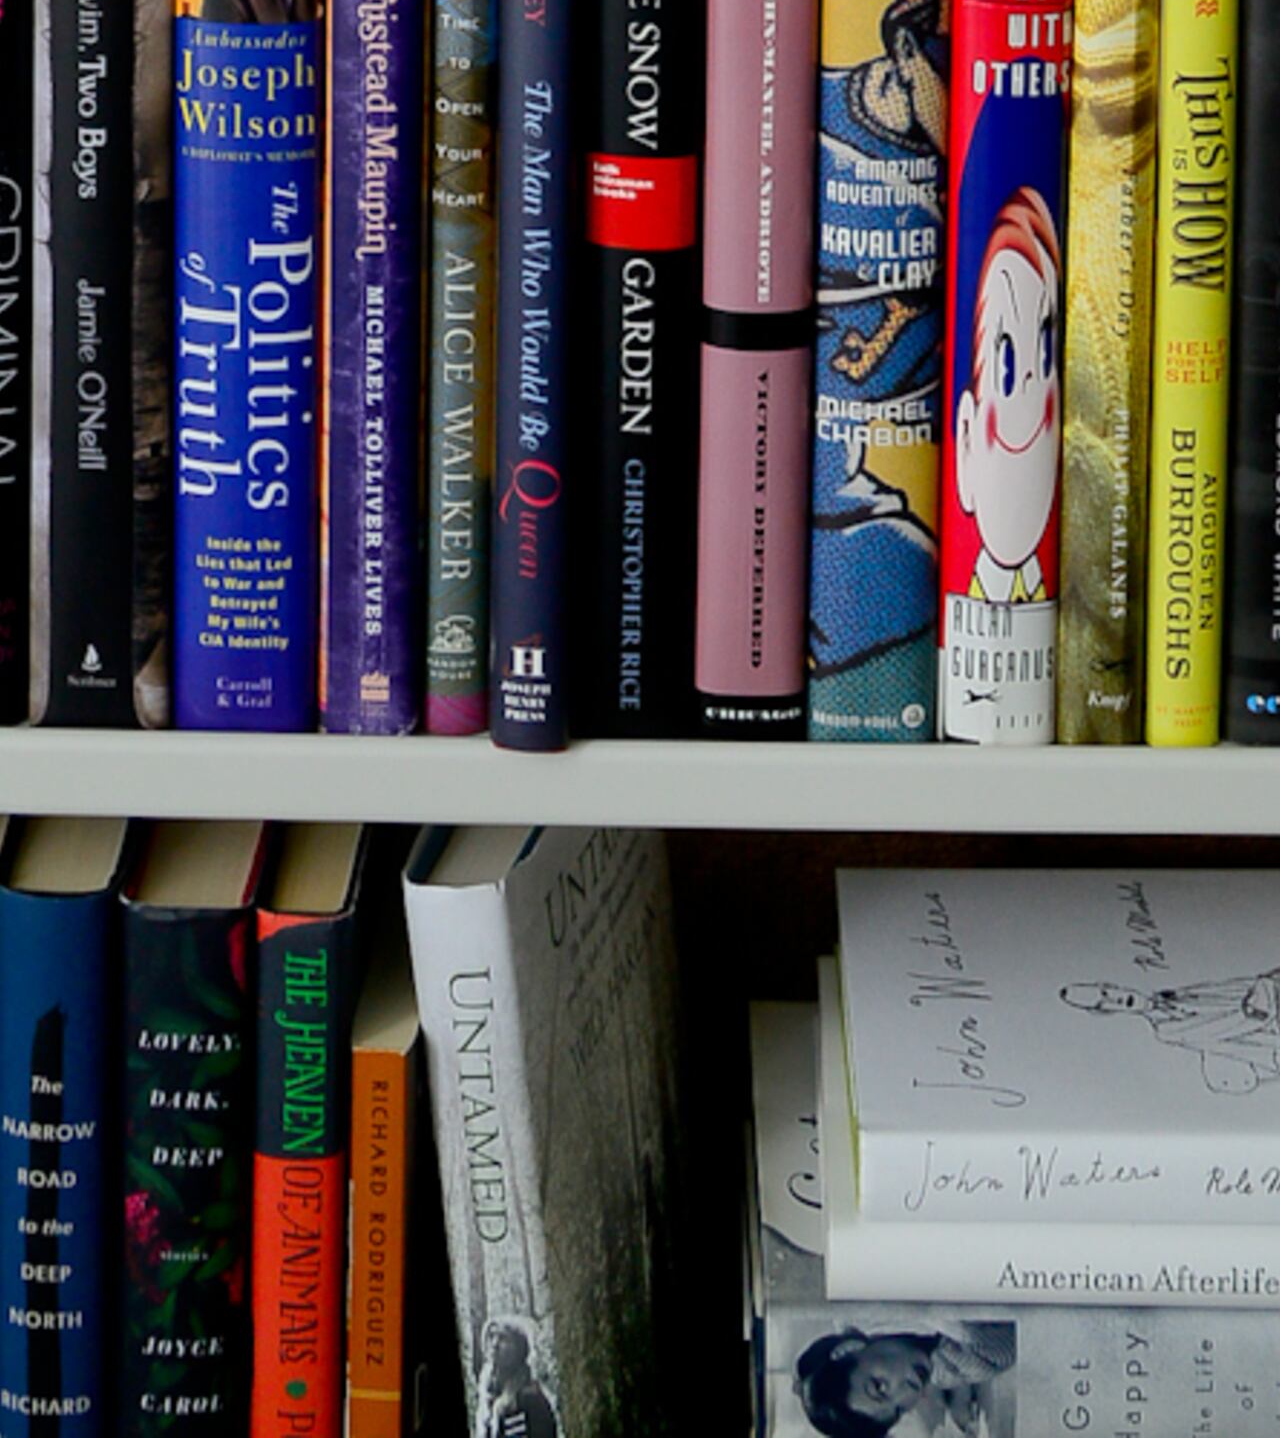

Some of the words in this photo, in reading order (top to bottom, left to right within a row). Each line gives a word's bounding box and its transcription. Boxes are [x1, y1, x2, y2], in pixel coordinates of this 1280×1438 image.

[176, 49, 317, 100] Joseph
[178, 97, 317, 139] Wilson
[440, 252, 475, 385] ALICE
[437, 399, 476, 583] WALKER
[2, 1118, 96, 1143] NARROW
[445, 968, 510, 1246] UNTAMED
[372, 1079, 389, 1198] RICHARD
[16, 1167, 77, 1190] ROAD
[365, 1211, 387, 1367] RODRIGUEZ
[995, 1260, 1145, 1293] American
[1153, 1265, 1280, 1296] Afterlife
[9, 1309, 82, 1330] NORTH
